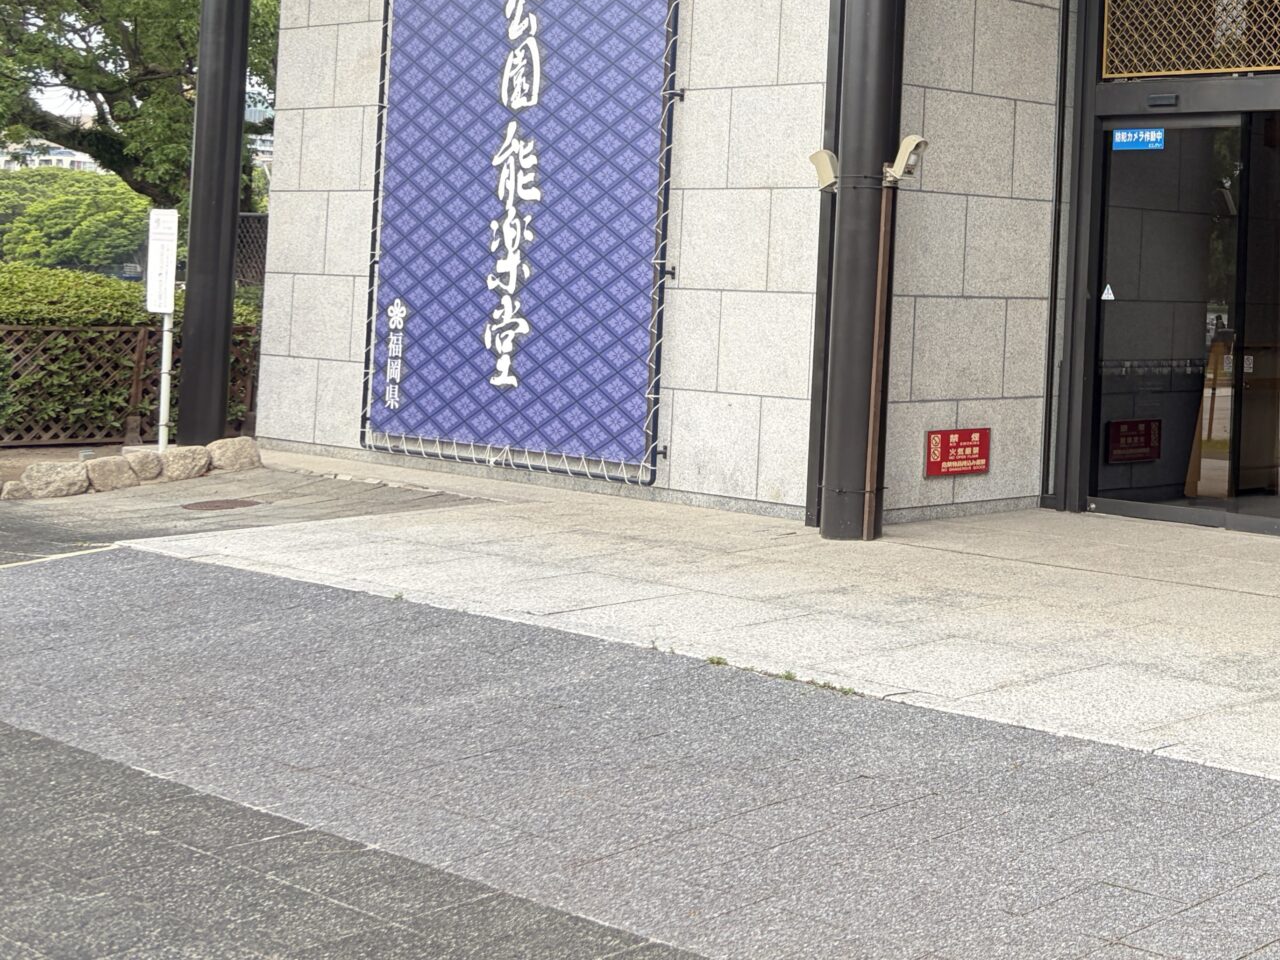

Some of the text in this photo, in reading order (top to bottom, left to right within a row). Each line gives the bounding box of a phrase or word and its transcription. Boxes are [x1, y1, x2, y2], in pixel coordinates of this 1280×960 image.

[1115, 130, 1163, 142] 防犯カメラ作動中
[384, 331, 404, 410] 福岡県
[949, 447, 979, 456] 火気厳禁
